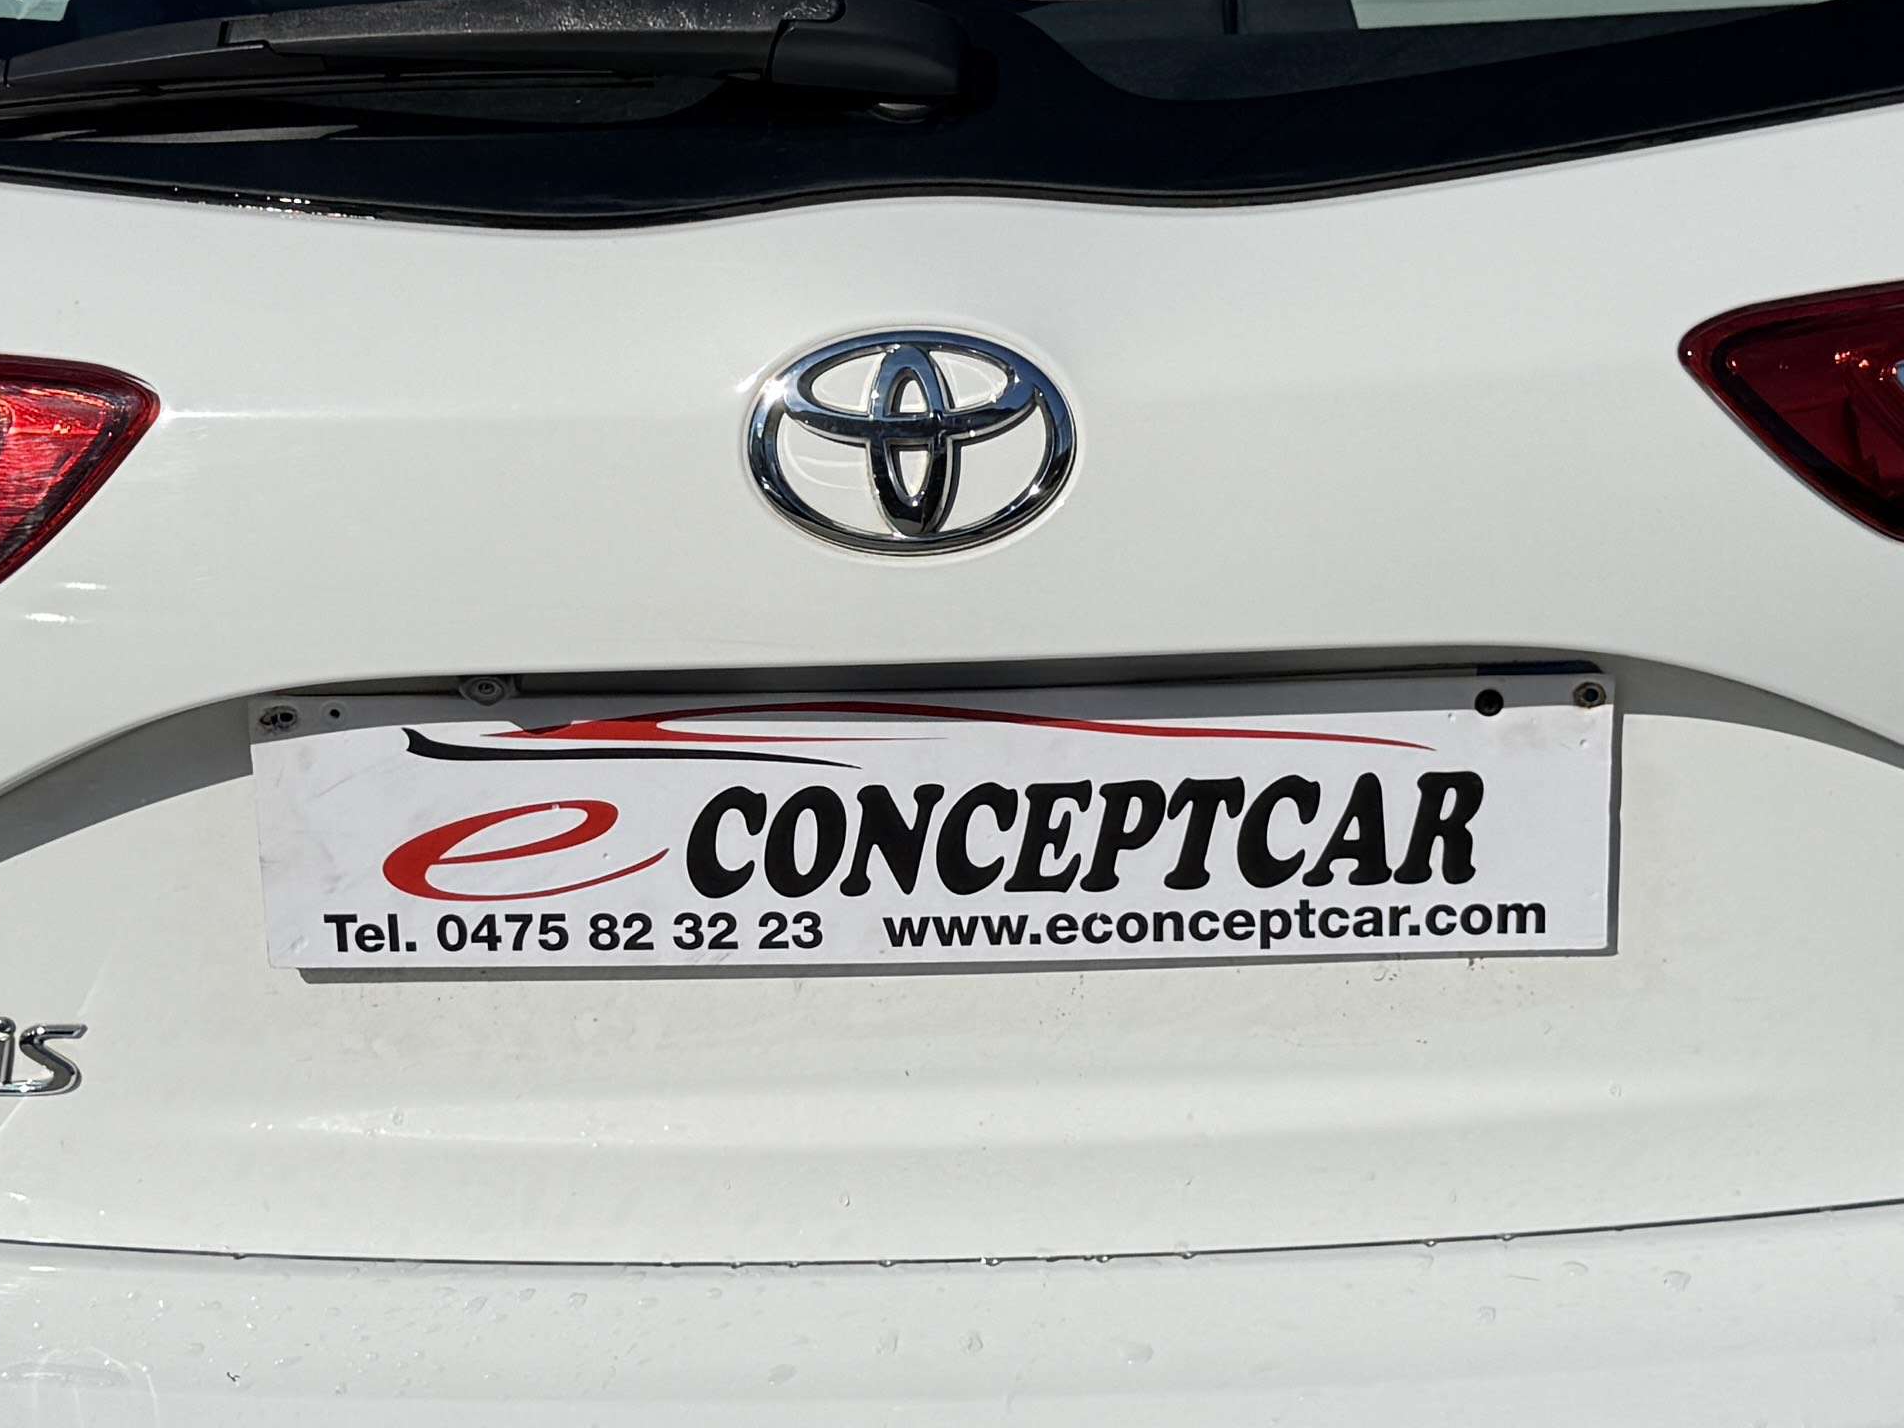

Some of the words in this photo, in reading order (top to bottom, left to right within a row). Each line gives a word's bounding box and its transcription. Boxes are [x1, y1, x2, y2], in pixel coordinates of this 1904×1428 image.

[382, 798, 670, 902] e
[685, 770, 1485, 900] CONCEPTCAR
[323, 912, 417, 953] Tel.
[436, 912, 571, 953] 0475
[588, 912, 656, 952] 82
[672, 911, 740, 952] 32
[757, 910, 825, 951] 23
[883, 898, 1548, 950] www.econceptcar.com
